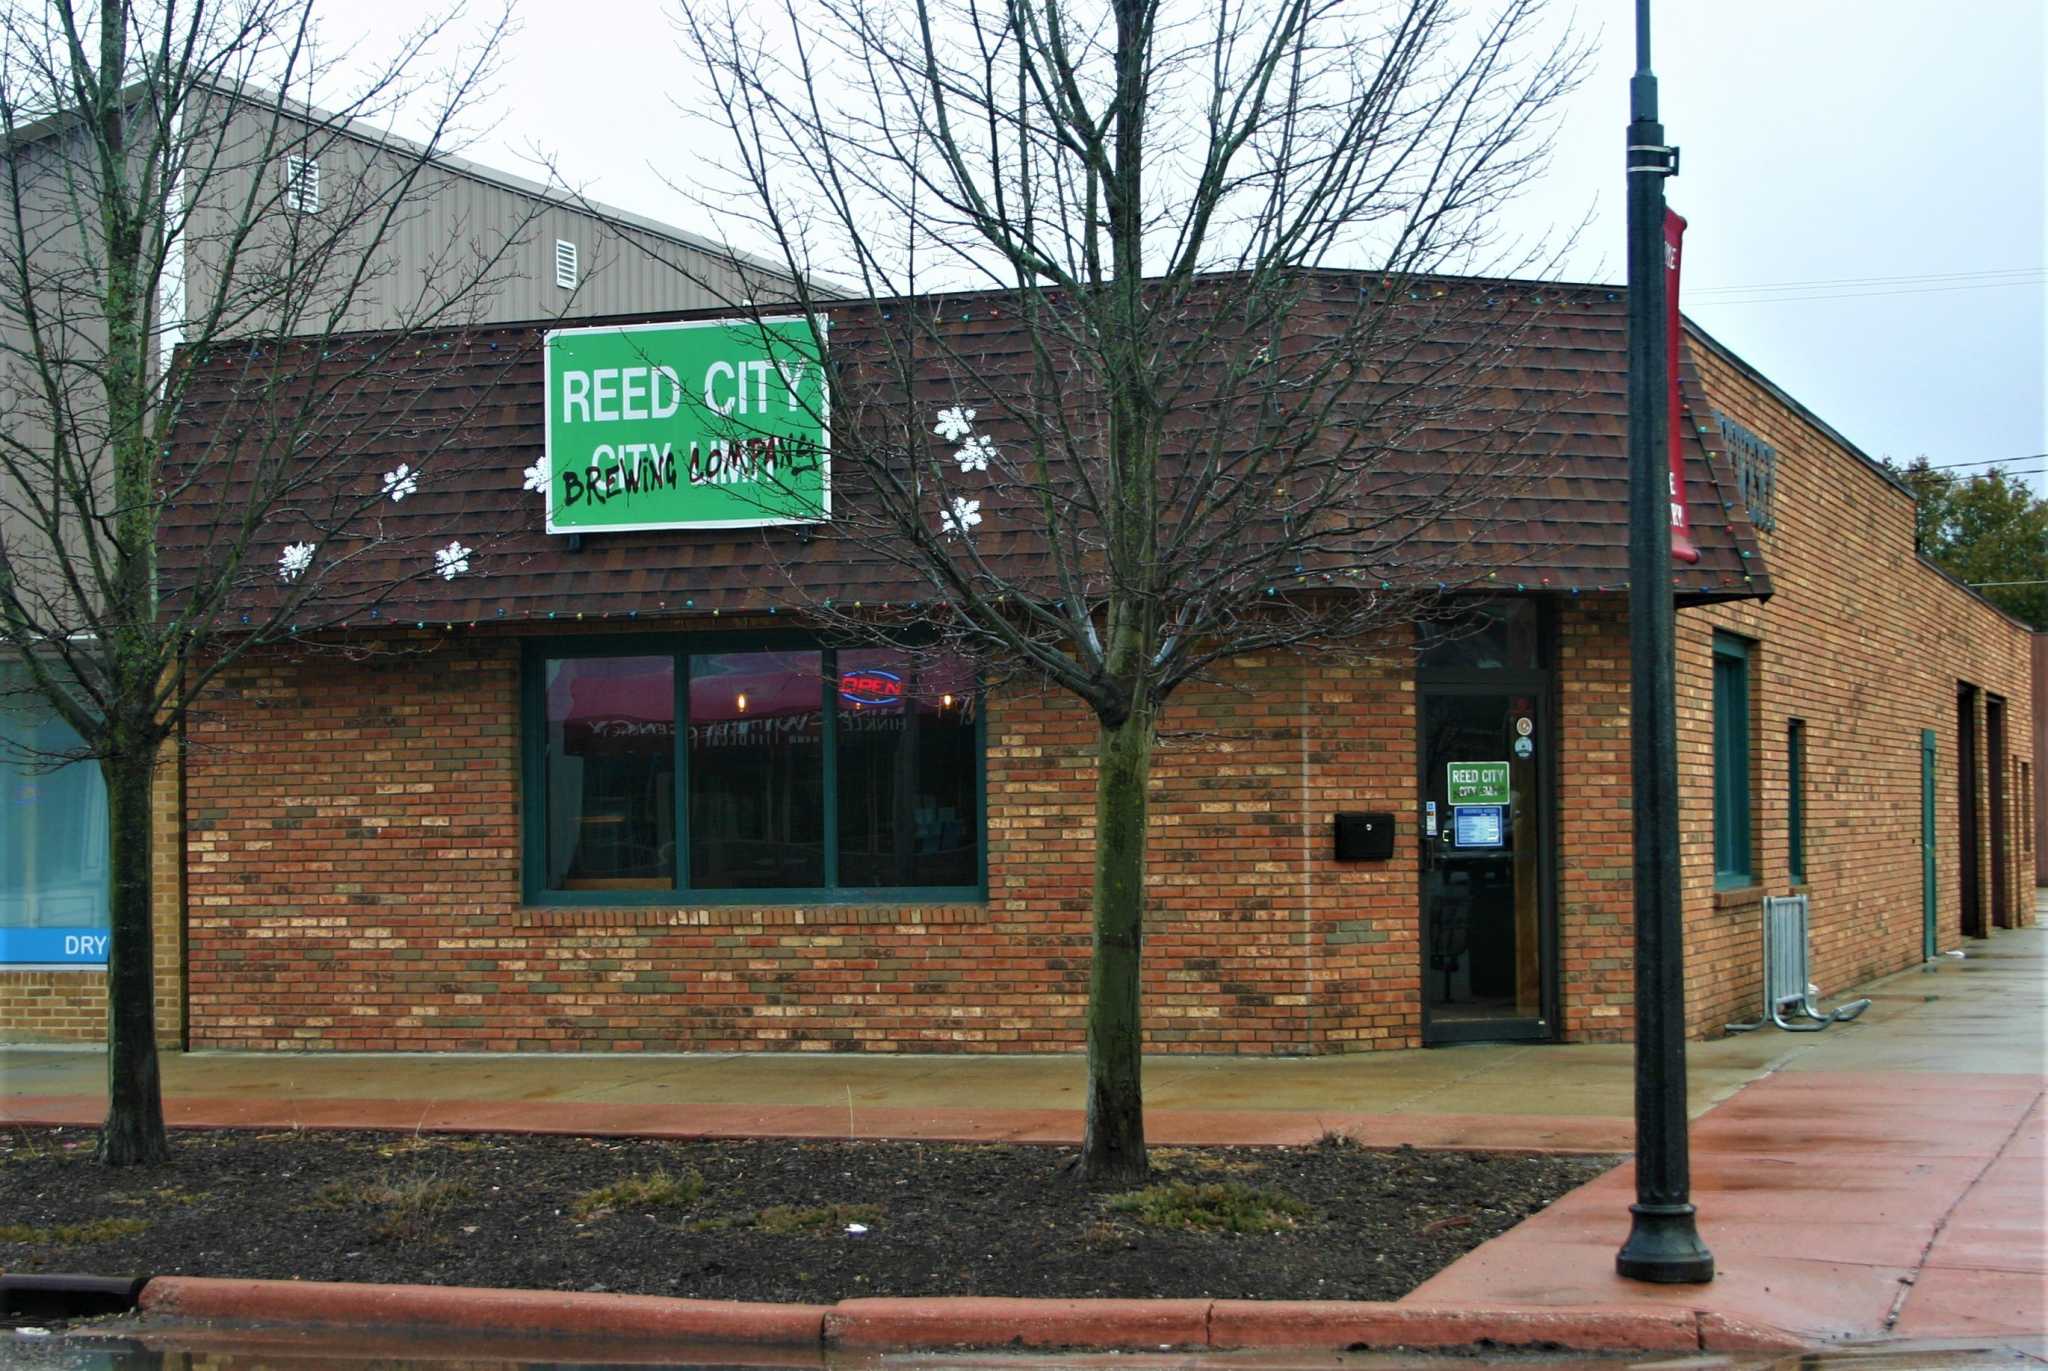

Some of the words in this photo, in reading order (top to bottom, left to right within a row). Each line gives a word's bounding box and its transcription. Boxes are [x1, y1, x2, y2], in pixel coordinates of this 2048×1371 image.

[563, 366, 680, 422] REED
[704, 357, 807, 416] CITY
[591, 443, 671, 490] CITY
[690, 432, 819, 482] COMPANY
[840, 677, 903, 695] OPEN
[1452, 769, 1479, 783] REED
[1481, 769, 1505, 783] CITY
[65, 935, 107, 955] DRY
